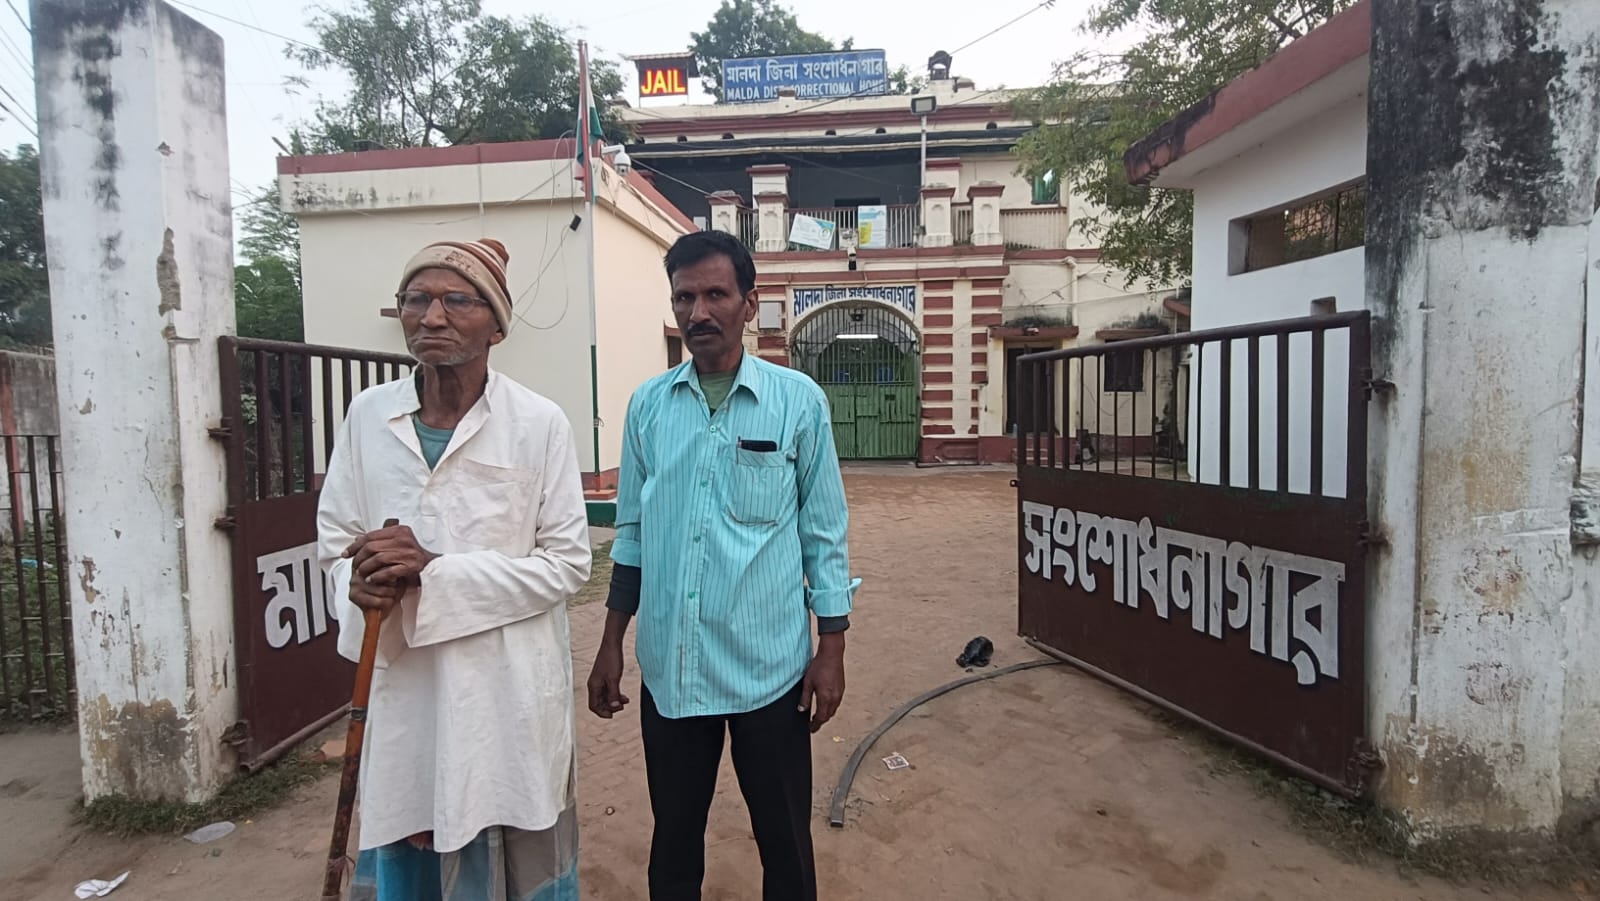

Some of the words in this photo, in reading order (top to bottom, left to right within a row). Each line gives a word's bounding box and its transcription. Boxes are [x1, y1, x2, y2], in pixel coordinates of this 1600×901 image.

[641, 69, 686, 94] JAIL
[727, 87, 760, 100] MALDA
[791, 81, 855, 97] ORRECTIONAL
[859, 79, 884, 93] HOME
[793, 288, 824, 317] মালদা
[848, 285, 916, 314] সংশোধনাগার
[1022, 500, 1346, 685] সংশোধনাগার
